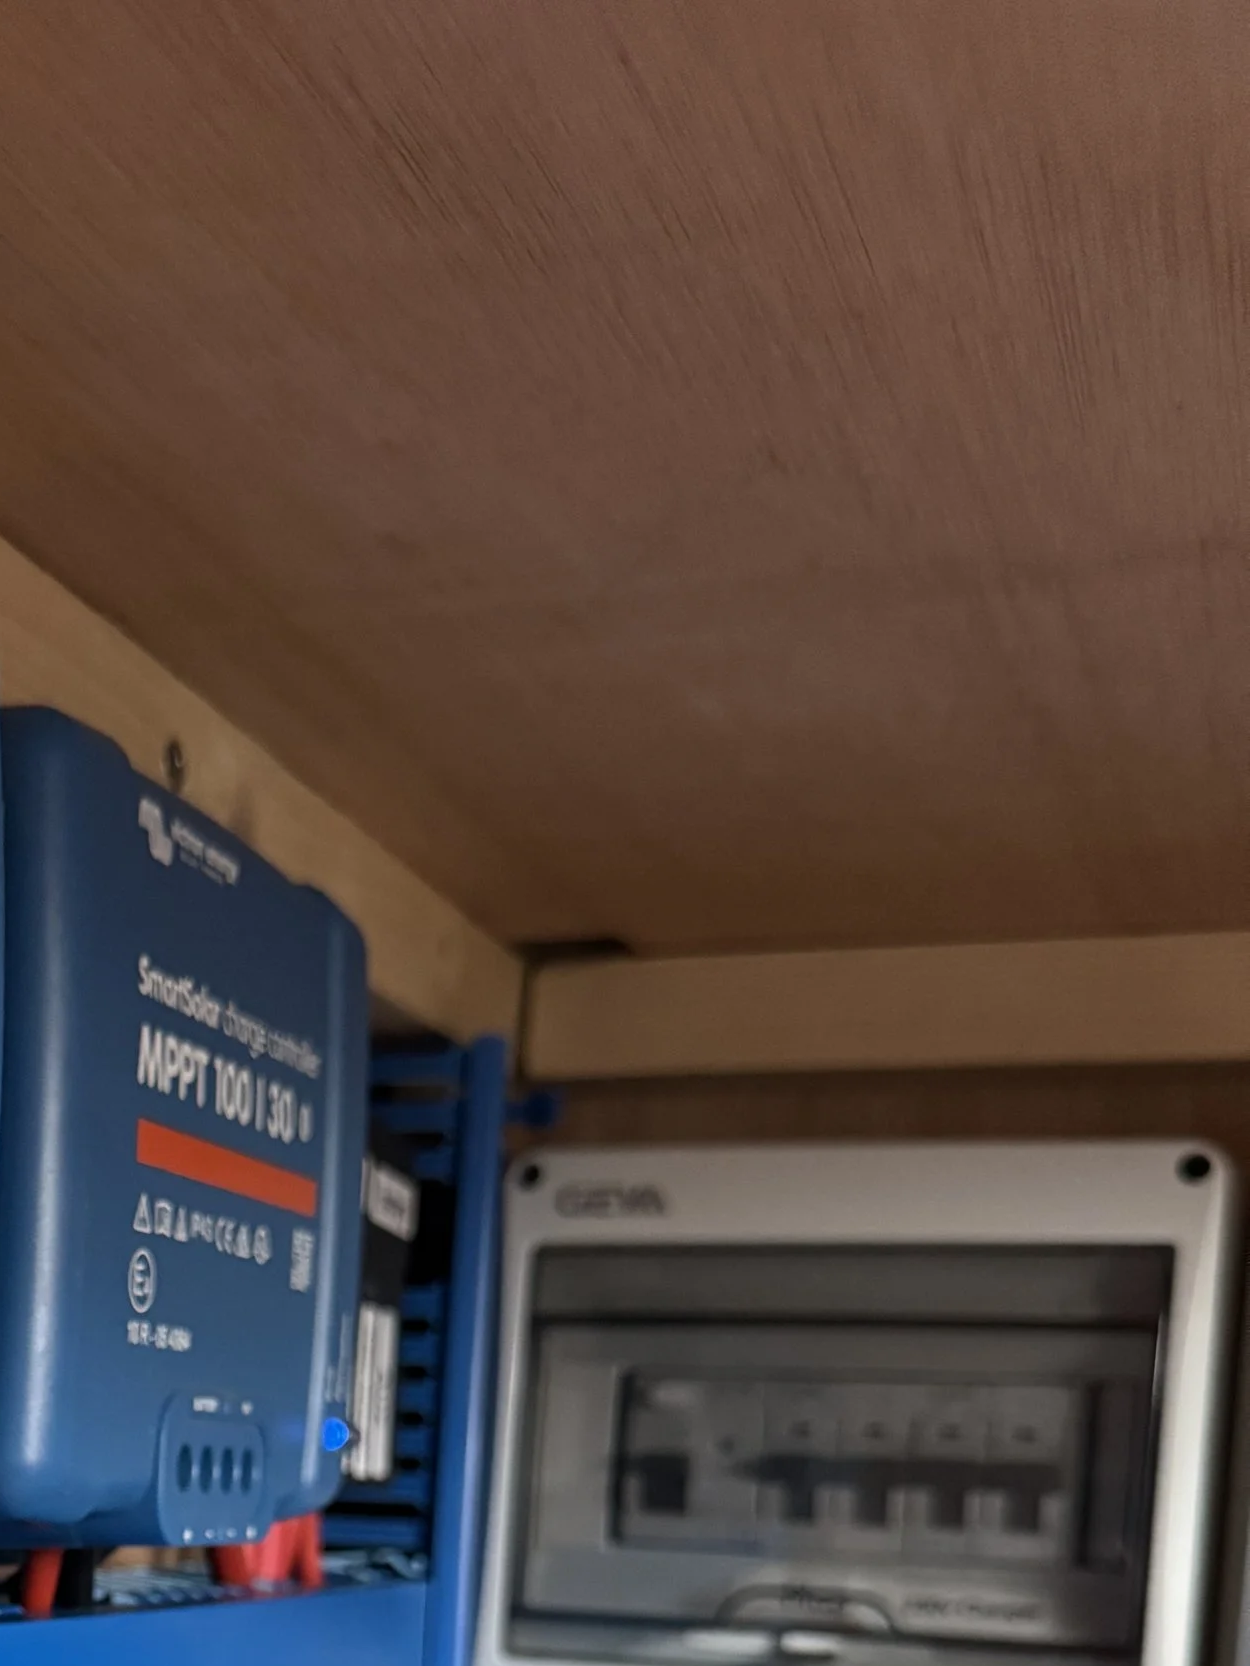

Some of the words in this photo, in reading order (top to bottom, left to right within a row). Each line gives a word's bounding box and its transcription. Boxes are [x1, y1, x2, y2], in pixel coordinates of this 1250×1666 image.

[137, 1024, 210, 1109] MPPT
[213, 1055, 254, 1127] 100
[267, 1081, 297, 1145] 30
